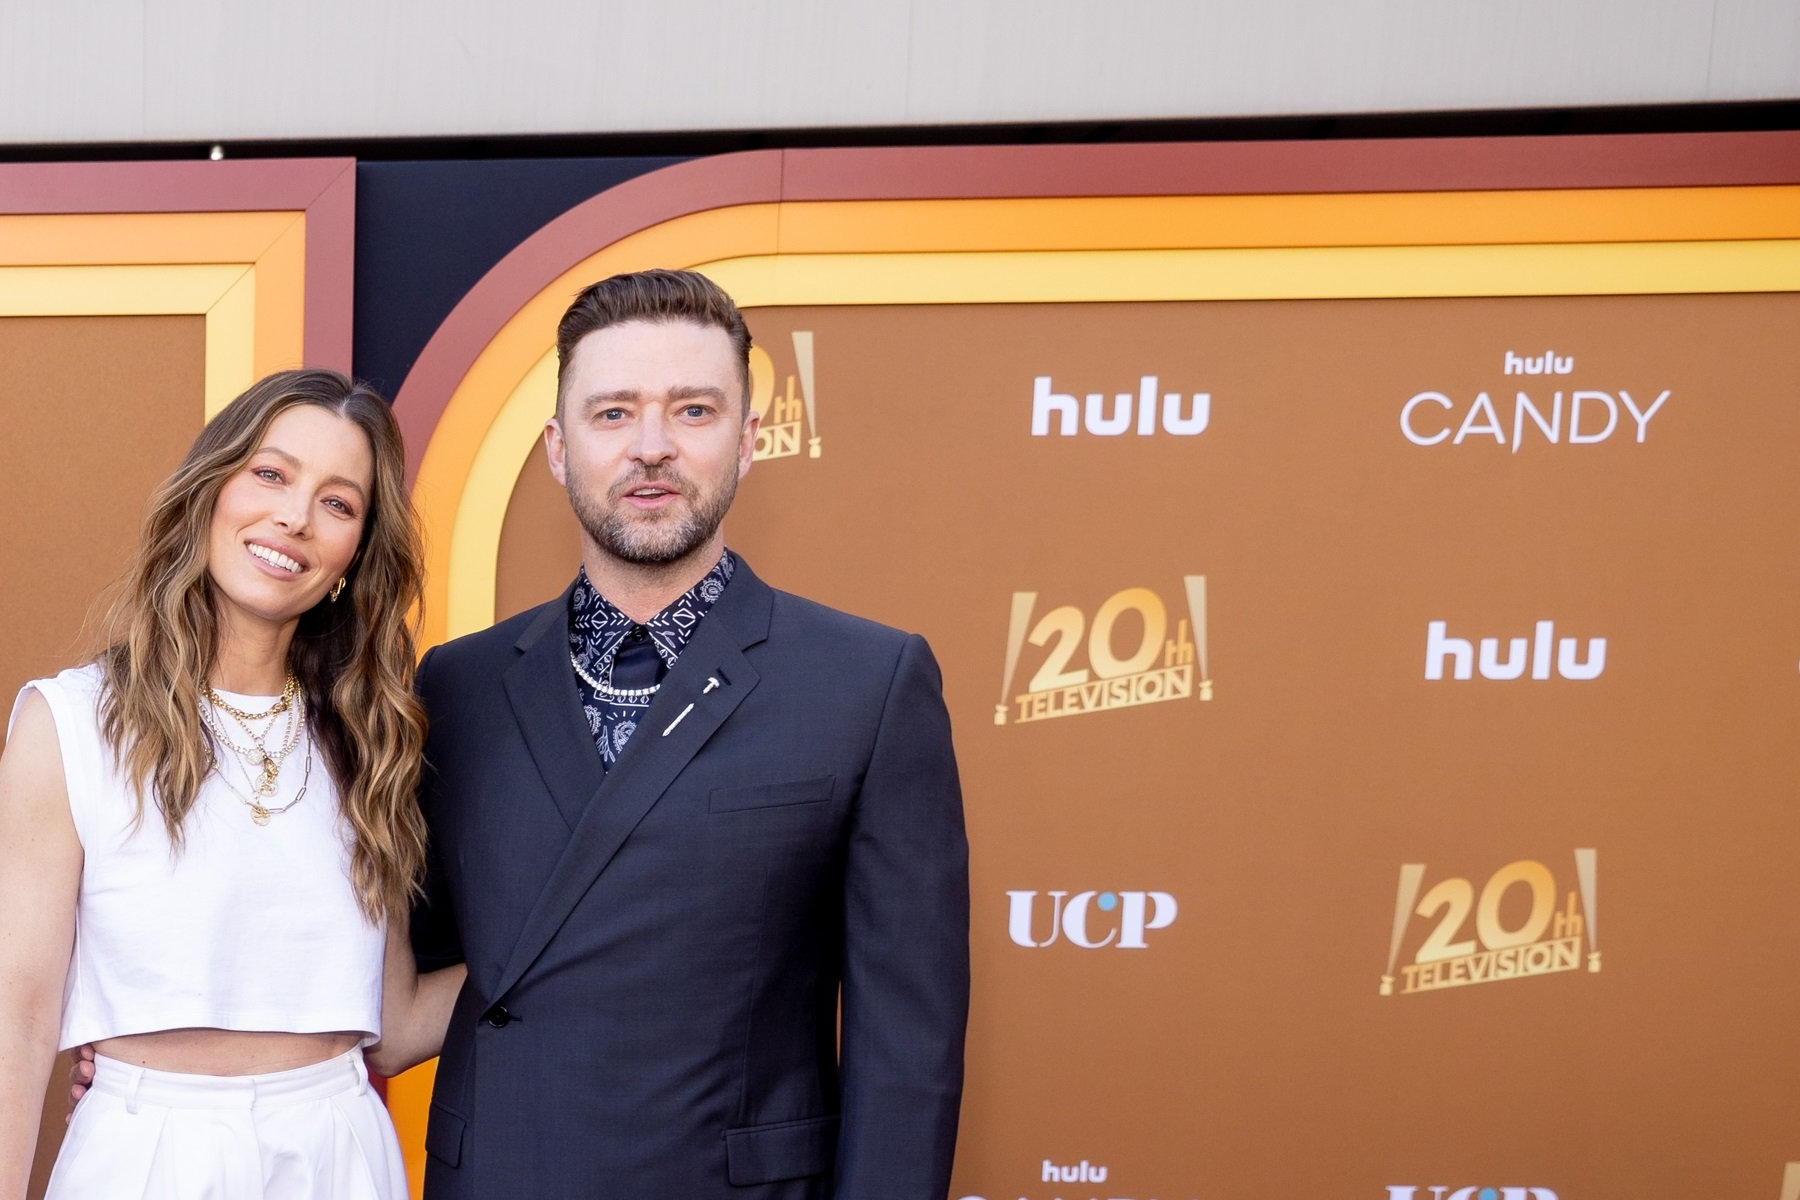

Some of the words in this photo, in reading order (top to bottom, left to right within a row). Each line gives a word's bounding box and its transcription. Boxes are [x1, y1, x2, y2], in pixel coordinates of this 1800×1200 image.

[1503, 350, 1574, 376] hulu
[1031, 375, 1212, 437] hulu
[1399, 389, 1672, 454] CANDY
[1027, 586, 1194, 692] 20th
[1424, 620, 1607, 681] hulu
[1014, 663, 1194, 724] TELEVISION
[1005, 890, 1178, 949] UCP
[1415, 859, 1584, 963] 20th
[1401, 935, 1582, 994] TELEVISION
[1041, 1159, 1108, 1183] hulu
